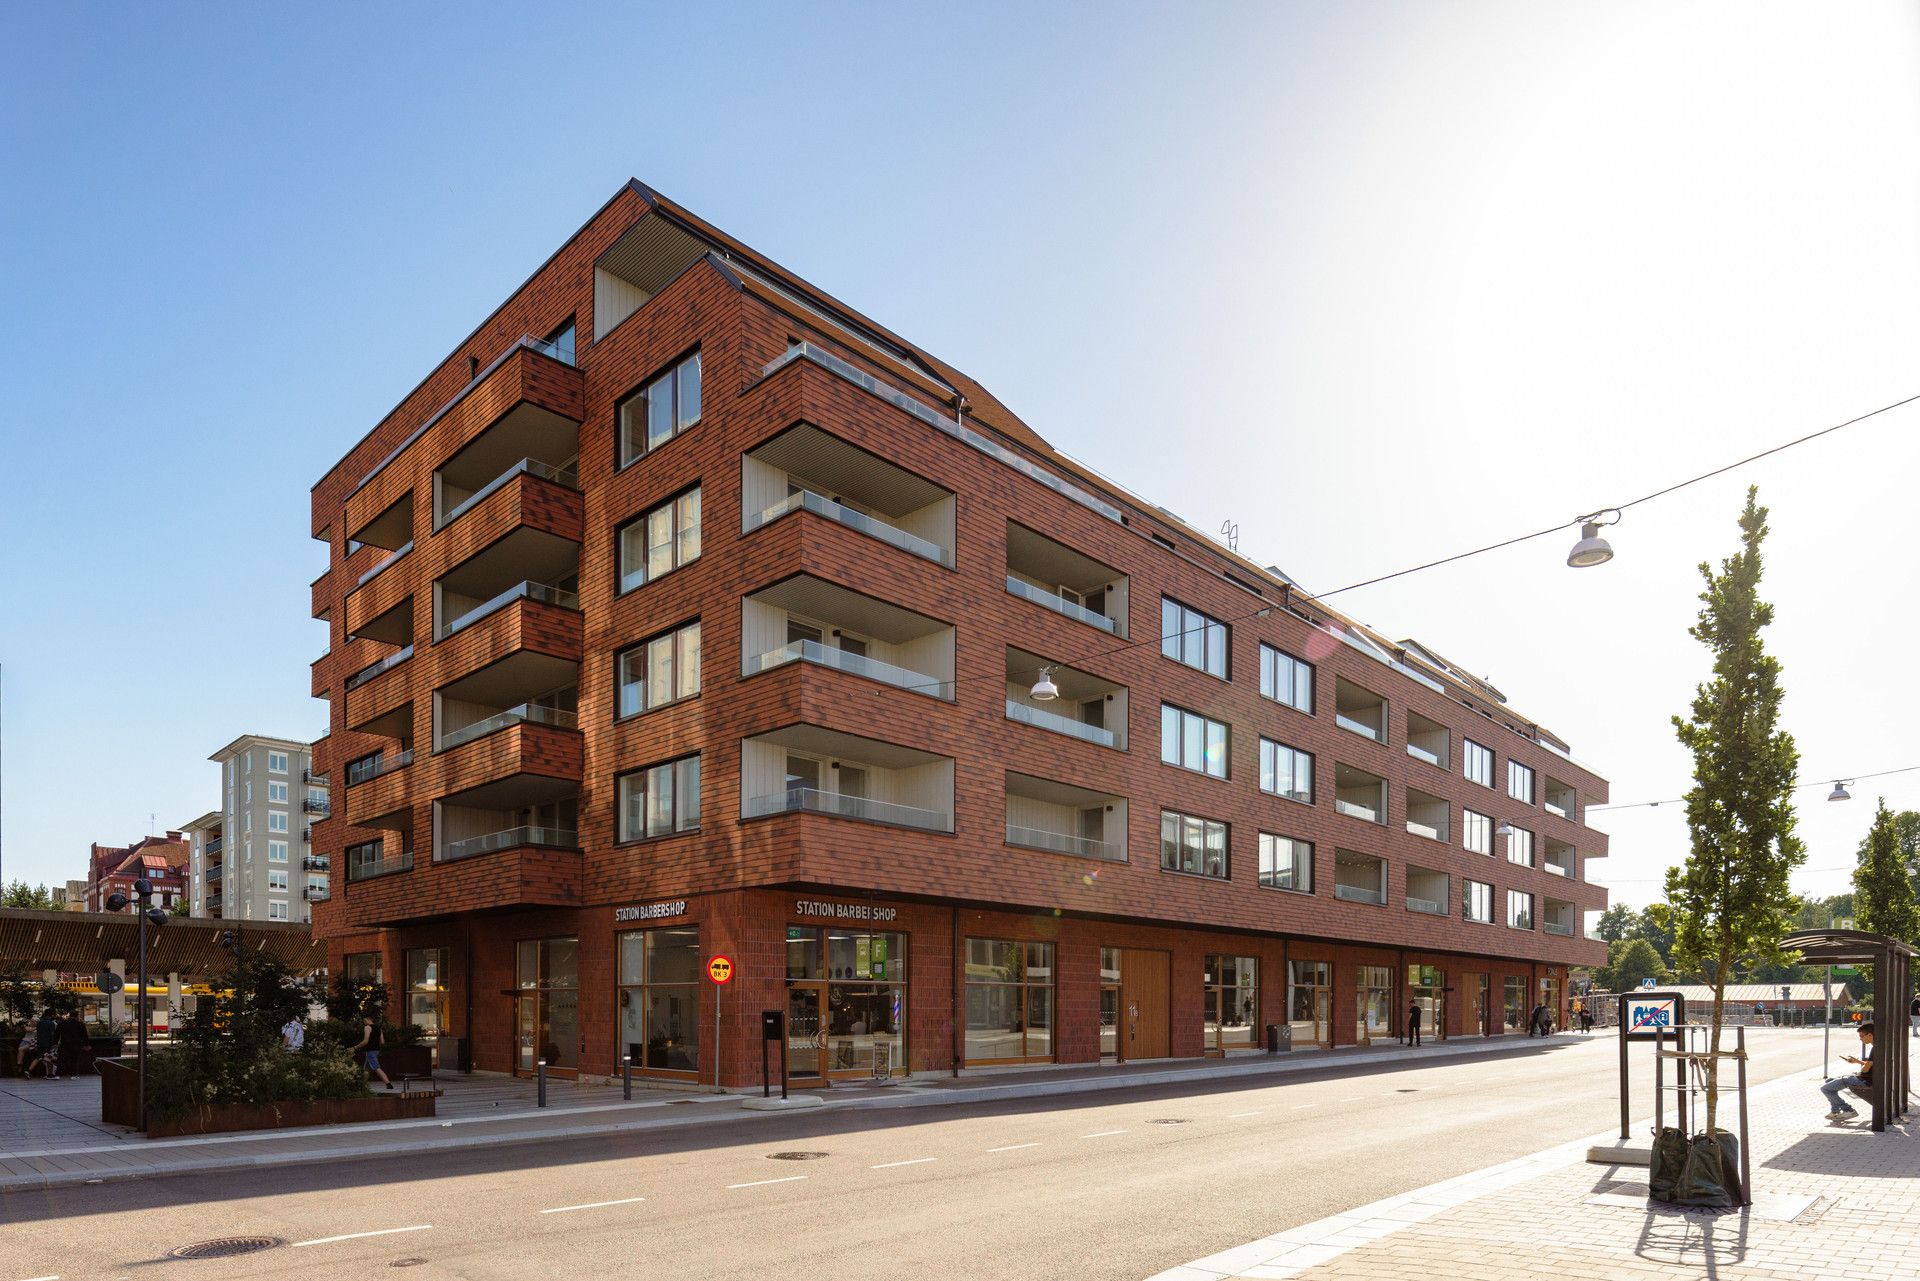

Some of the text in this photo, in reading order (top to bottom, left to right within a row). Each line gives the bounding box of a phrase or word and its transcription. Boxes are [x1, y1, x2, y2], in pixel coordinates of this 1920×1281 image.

[615, 901, 686, 922] STATION BARBERSHOP
[796, 901, 835, 916] STATION
